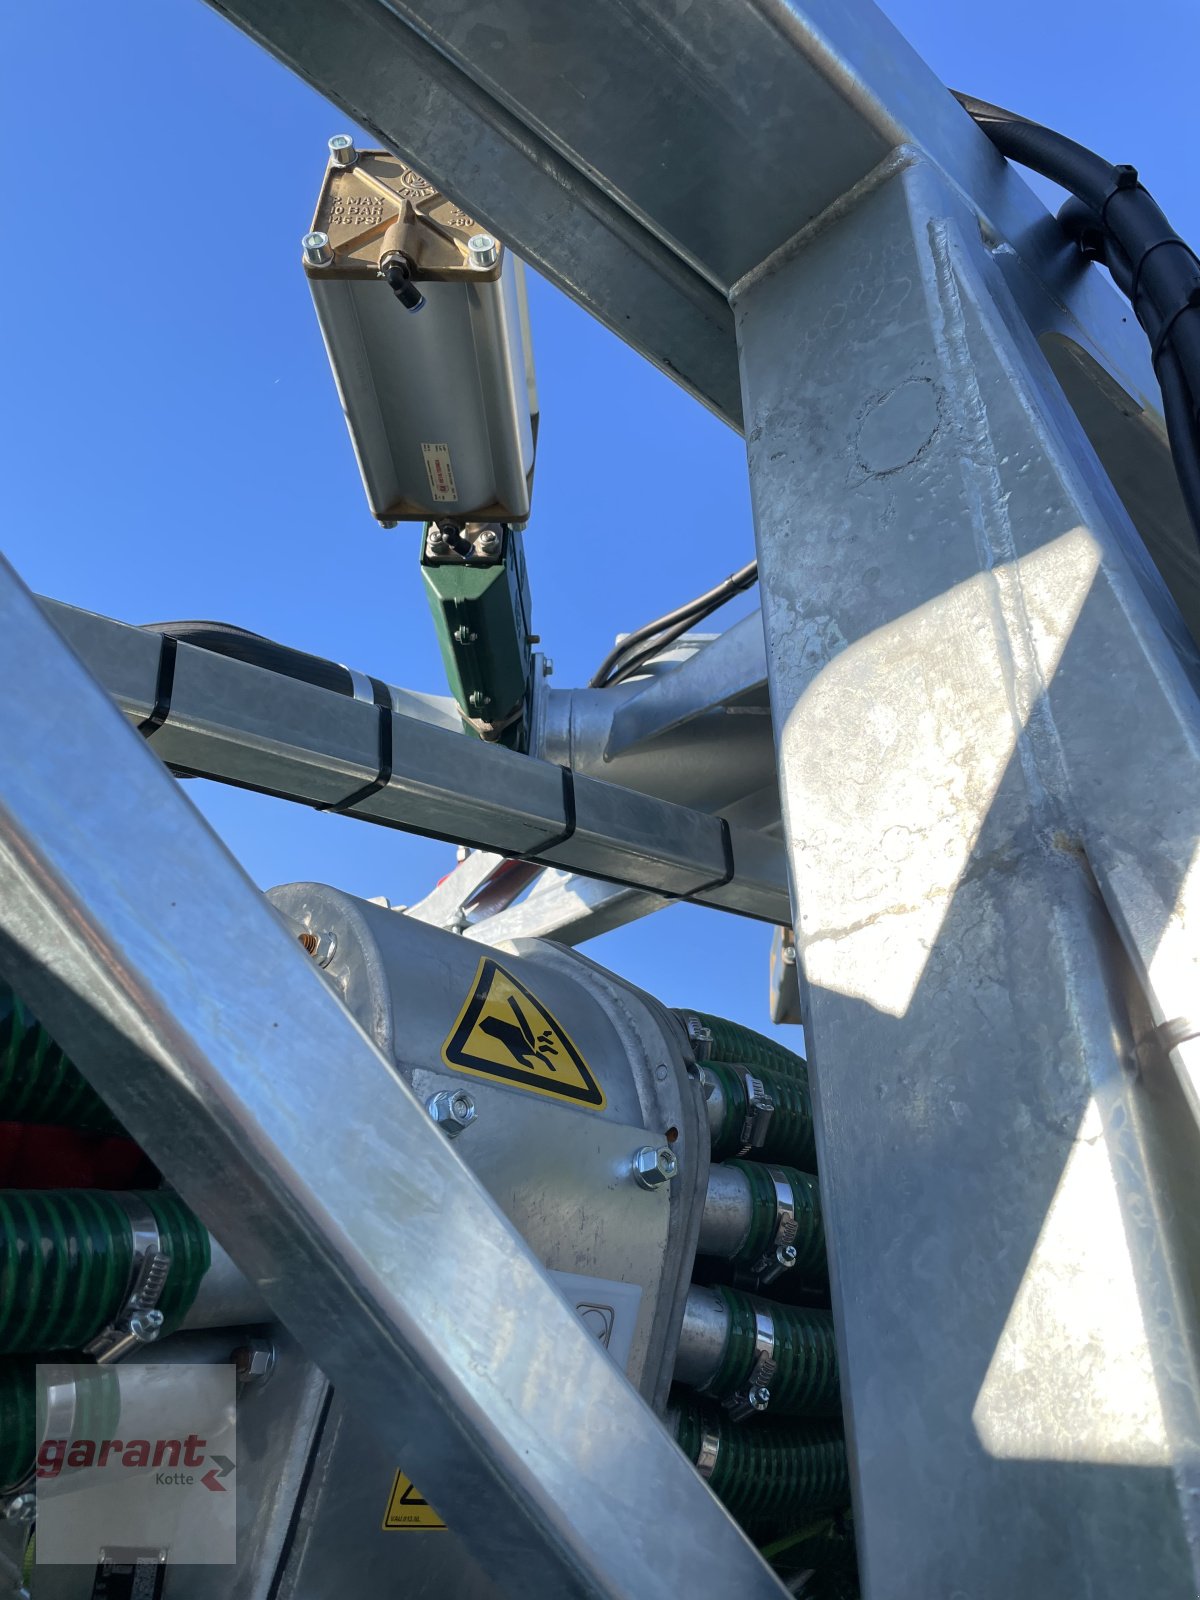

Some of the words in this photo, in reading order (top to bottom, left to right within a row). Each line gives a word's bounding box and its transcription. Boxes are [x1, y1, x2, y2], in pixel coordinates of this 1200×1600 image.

[346, 196, 385, 205] MAX
[330, 206, 344, 215] 10
[348, 206, 384, 216] BAR
[329, 216, 353, 225] 145
[354, 216, 382, 225] PSI
